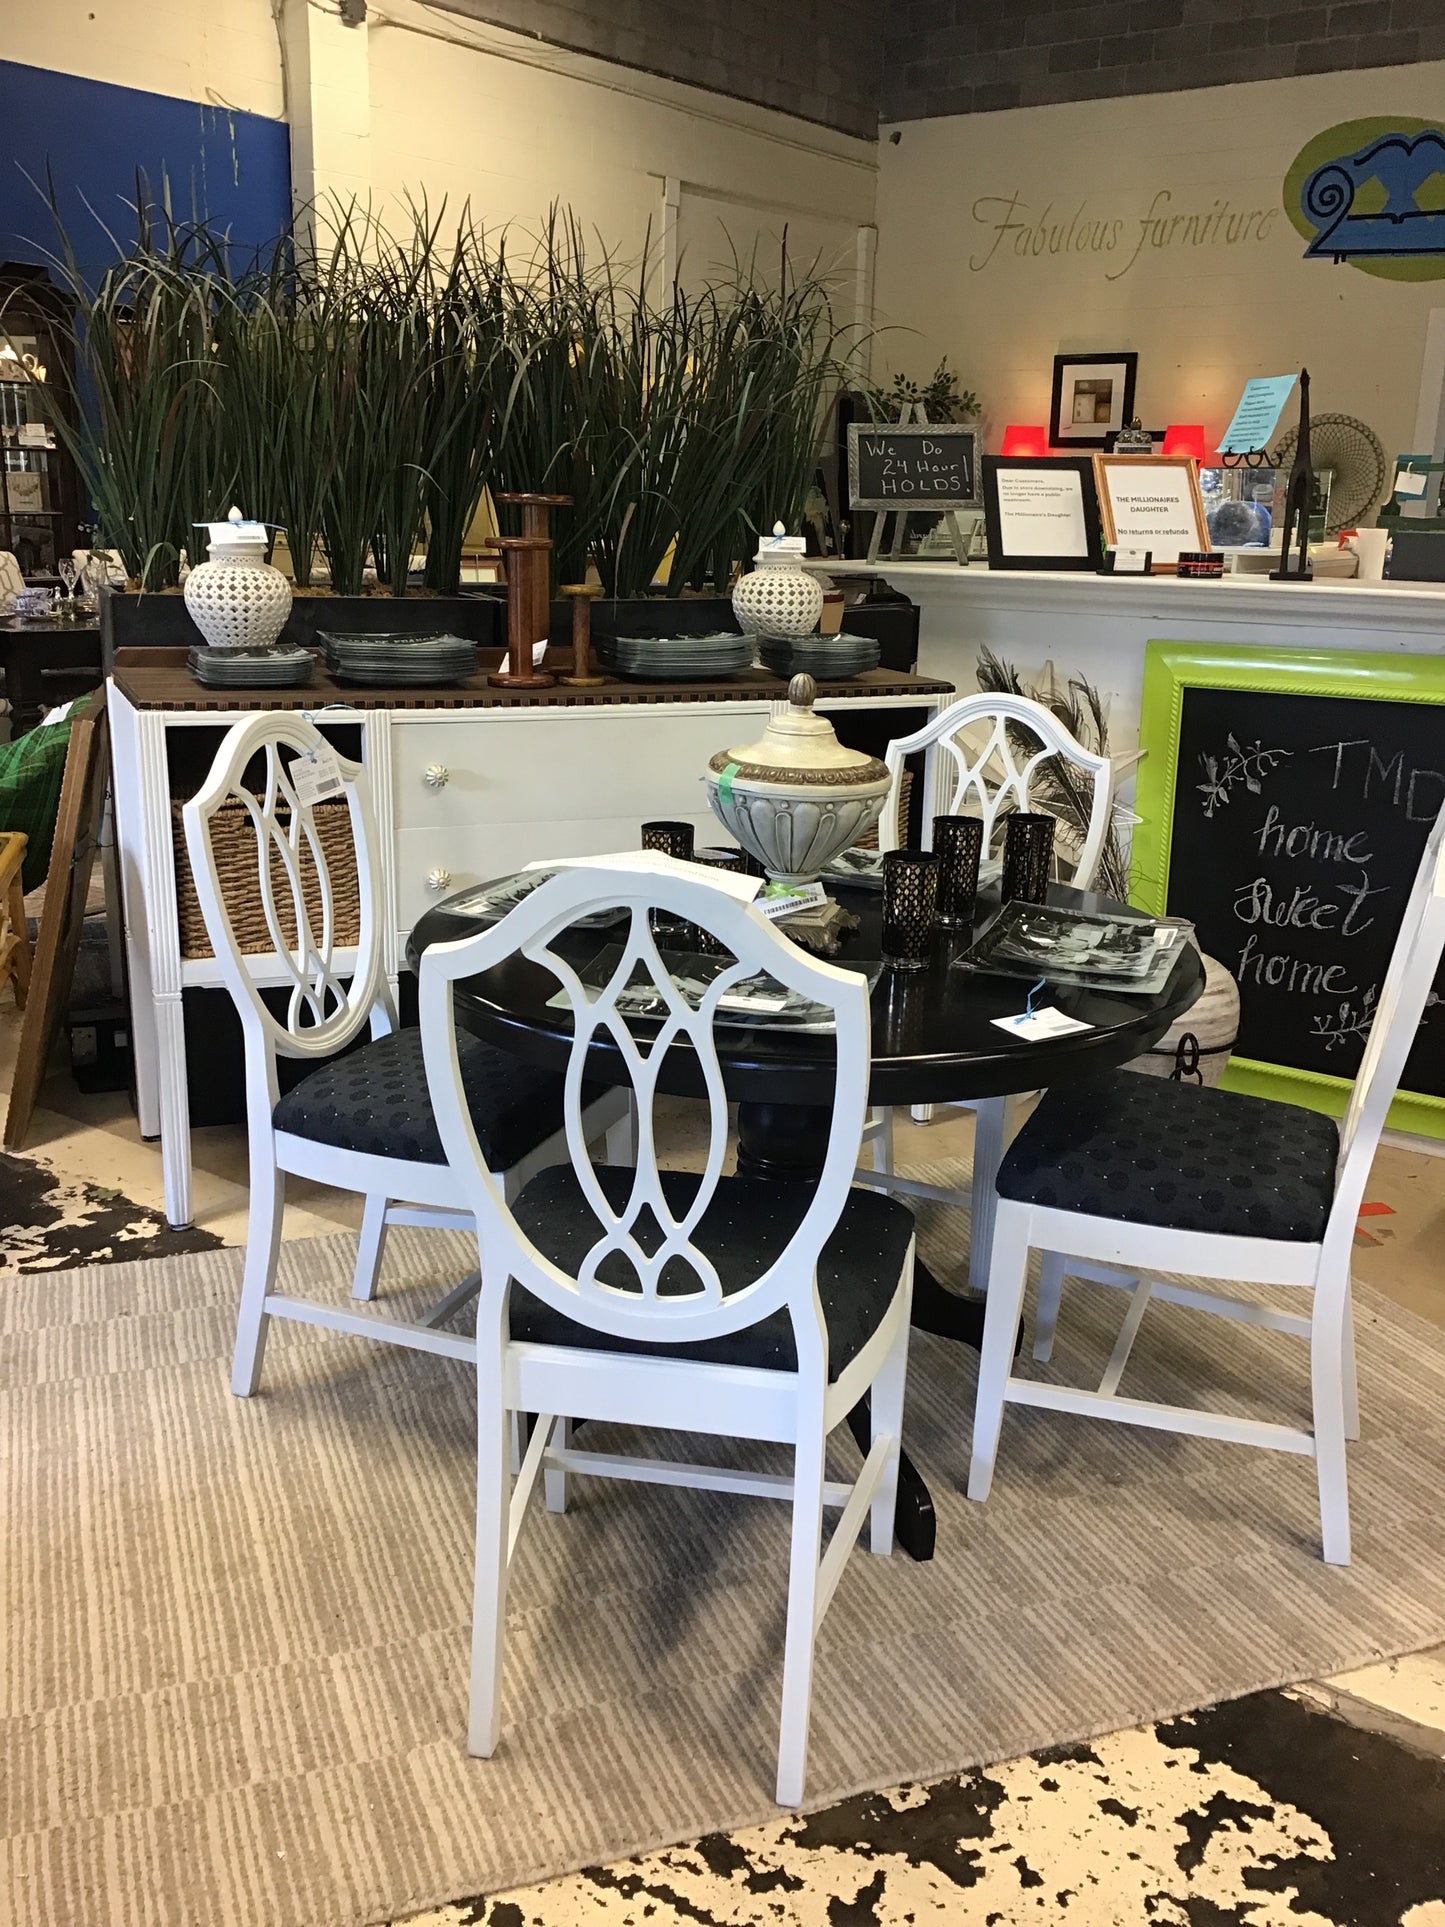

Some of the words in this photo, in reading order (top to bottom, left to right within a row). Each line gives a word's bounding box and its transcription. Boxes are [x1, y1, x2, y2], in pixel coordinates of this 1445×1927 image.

[969, 189, 1123, 272] Fabulous
[1104, 190, 1279, 281] furniture
[865, 440, 896, 456] We
[922, 440, 943, 455] Do
[883, 459, 908, 475] 24
[917, 460, 960, 473] Hour
[1308, 739, 1445, 821] TMD
[1253, 804, 1374, 863] home
[1238, 934, 1358, 994] home
